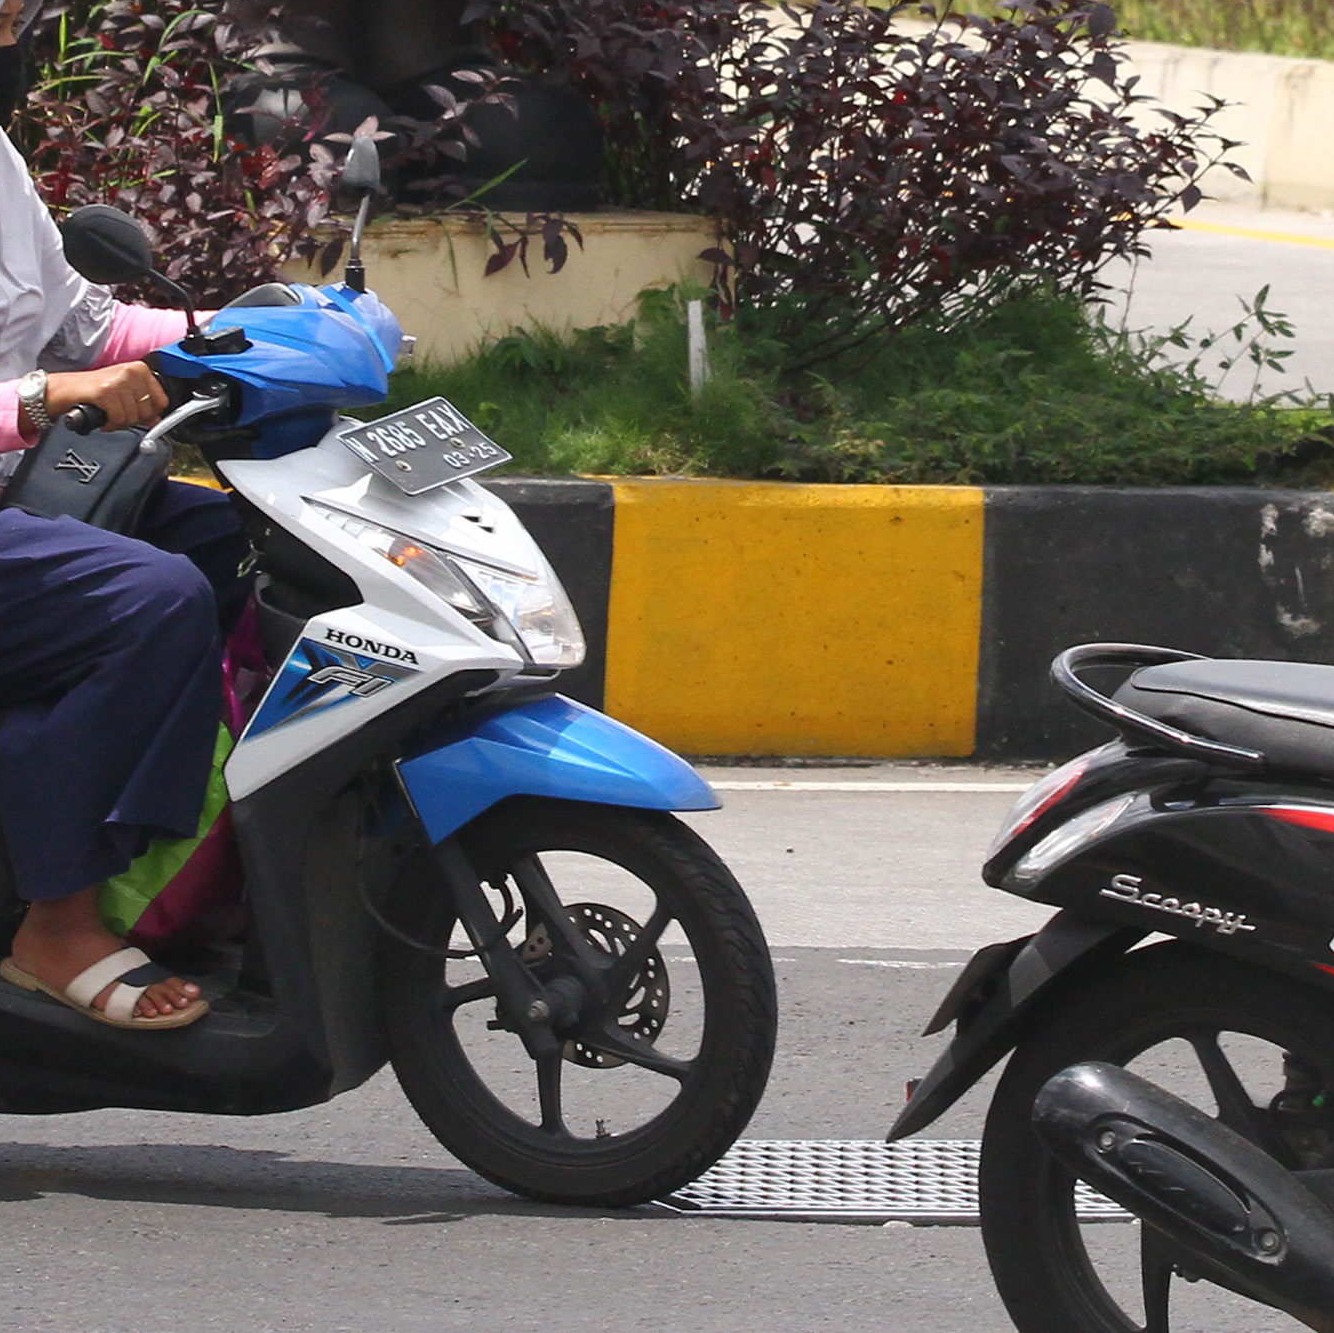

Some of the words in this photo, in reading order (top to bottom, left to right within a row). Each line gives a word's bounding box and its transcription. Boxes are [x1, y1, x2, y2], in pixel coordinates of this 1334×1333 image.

[366, 421, 427, 458] 2685
[416, 404, 470, 440] EAX
[325, 628, 419, 665] HONDA
[307, 665, 394, 698] FI
[1099, 874, 1256, 934] Scoopy
